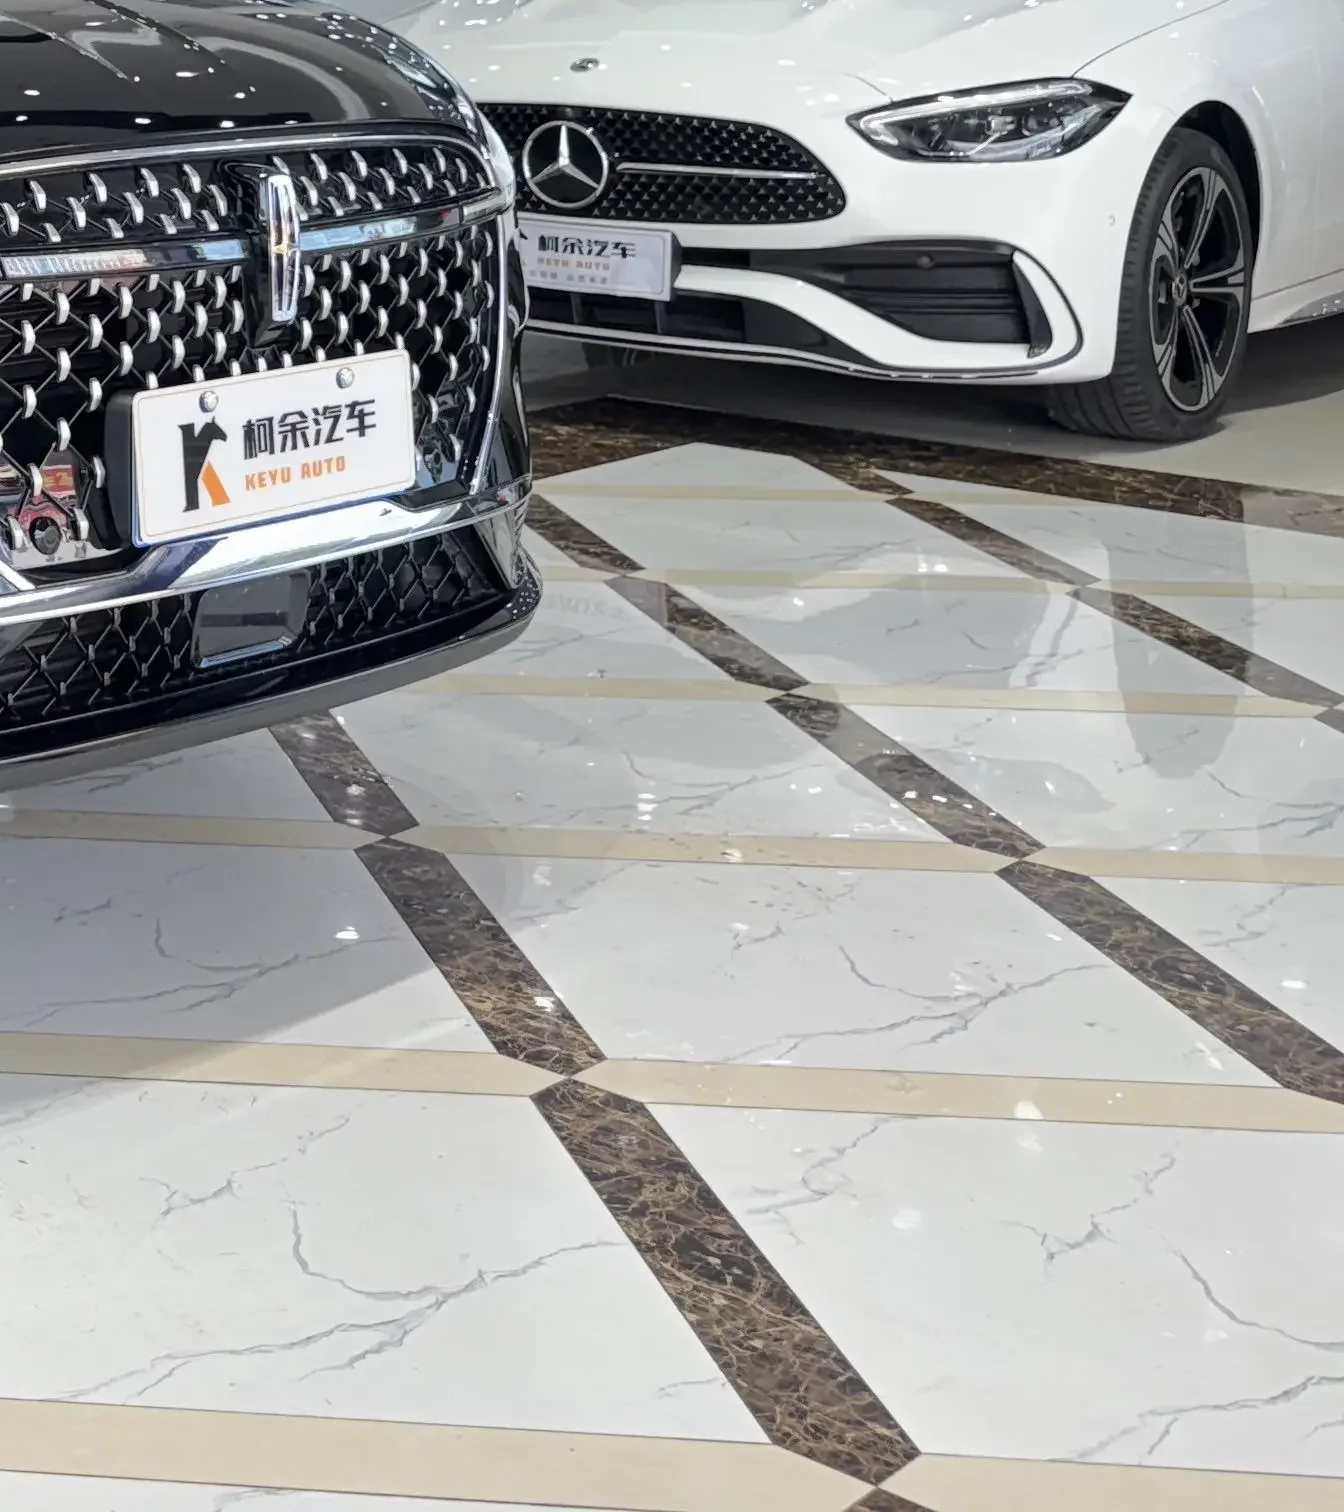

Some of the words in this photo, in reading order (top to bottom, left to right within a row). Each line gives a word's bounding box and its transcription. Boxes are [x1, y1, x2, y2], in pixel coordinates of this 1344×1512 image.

[538, 234, 637, 259] 柯余汽车
[241, 397, 377, 461] 柯余汽车
[244, 466, 292, 491] KEYU
[300, 455, 347, 479] AUTO
